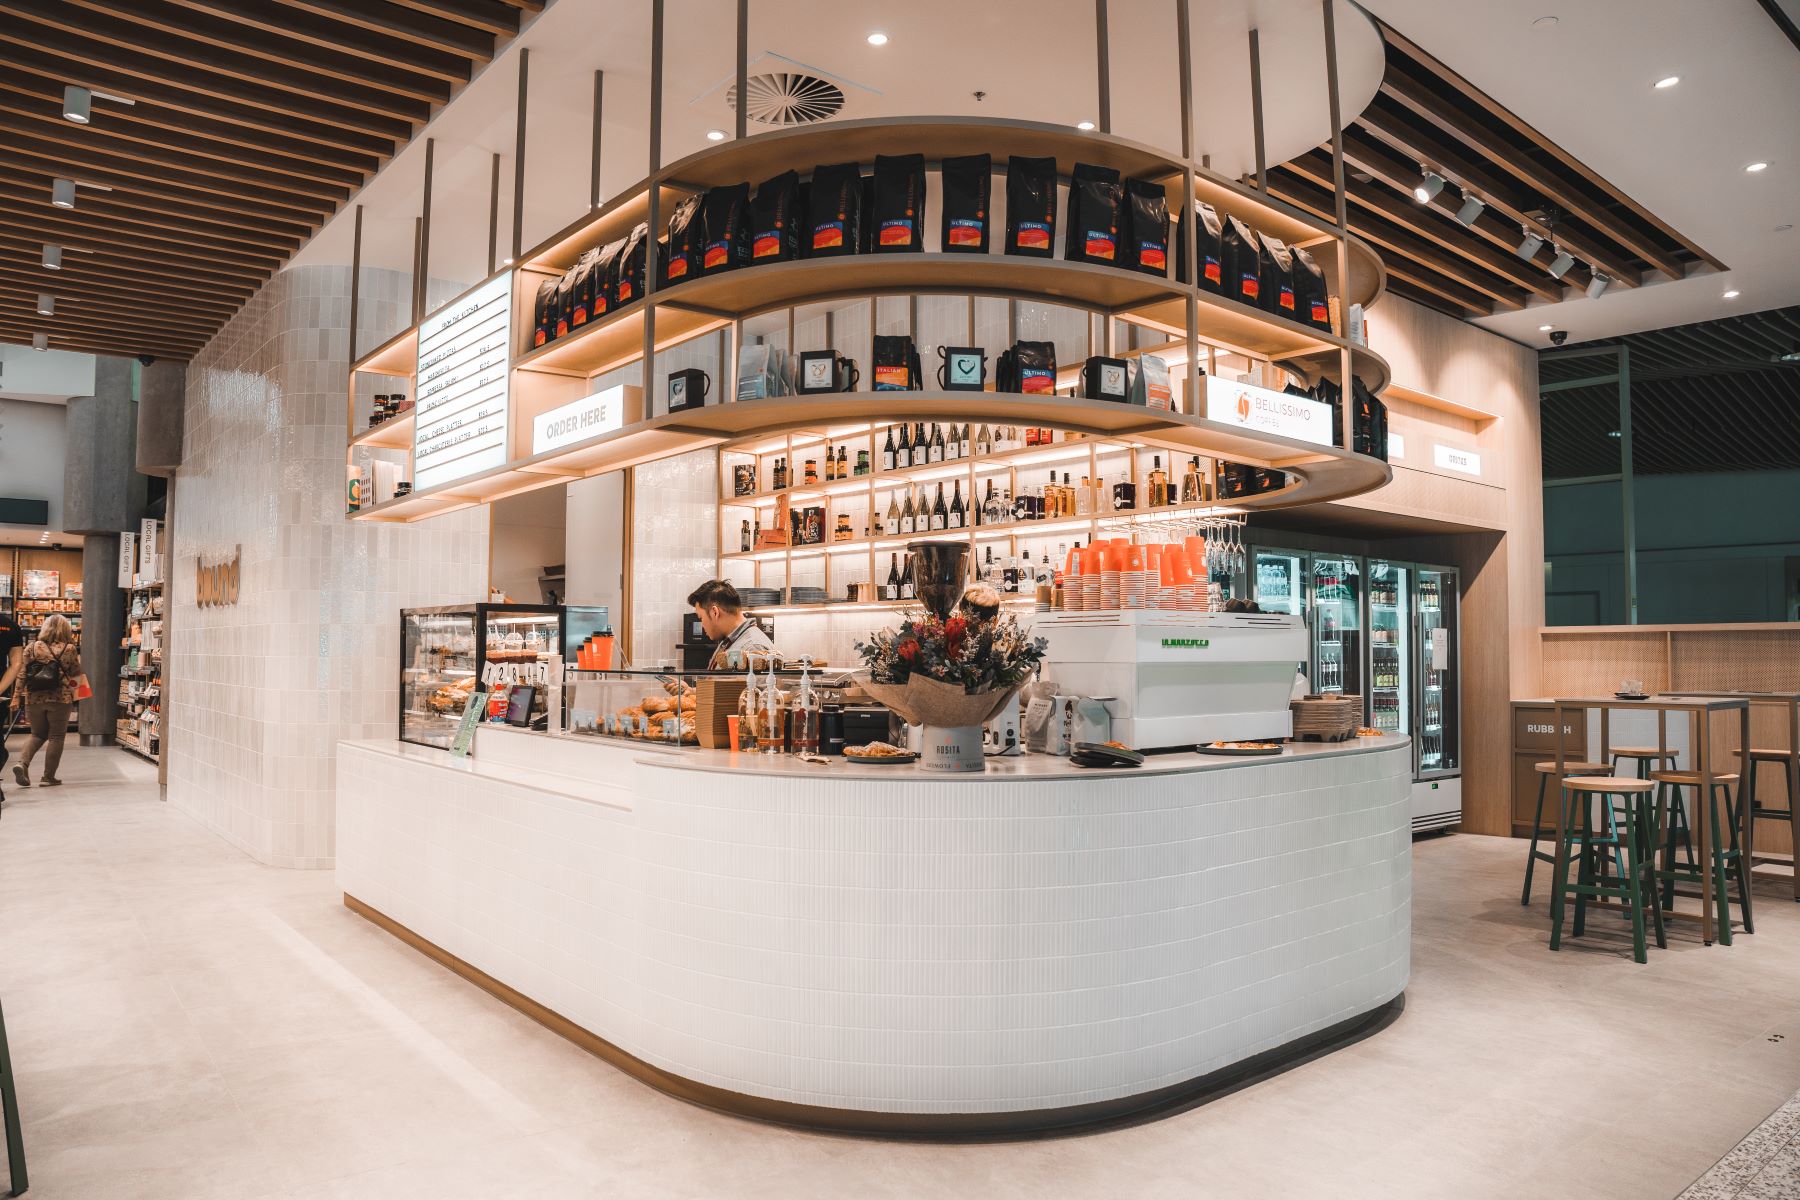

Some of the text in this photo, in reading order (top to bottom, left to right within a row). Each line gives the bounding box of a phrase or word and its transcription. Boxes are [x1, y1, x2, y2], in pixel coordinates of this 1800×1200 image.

[1088, 232, 1109, 240] ULTIMO
[1255, 397, 1311, 421] BELLISSIMO
[546, 405, 607, 440] ORDER HERE
[487, 666, 492, 681] 1
[498, 666, 504, 681] 2
[512, 667, 517, 682] 8
[540, 666, 545, 681] 7
[1527, 724, 1572, 734] RUBBH
[936, 745, 960, 755] ROSITA
